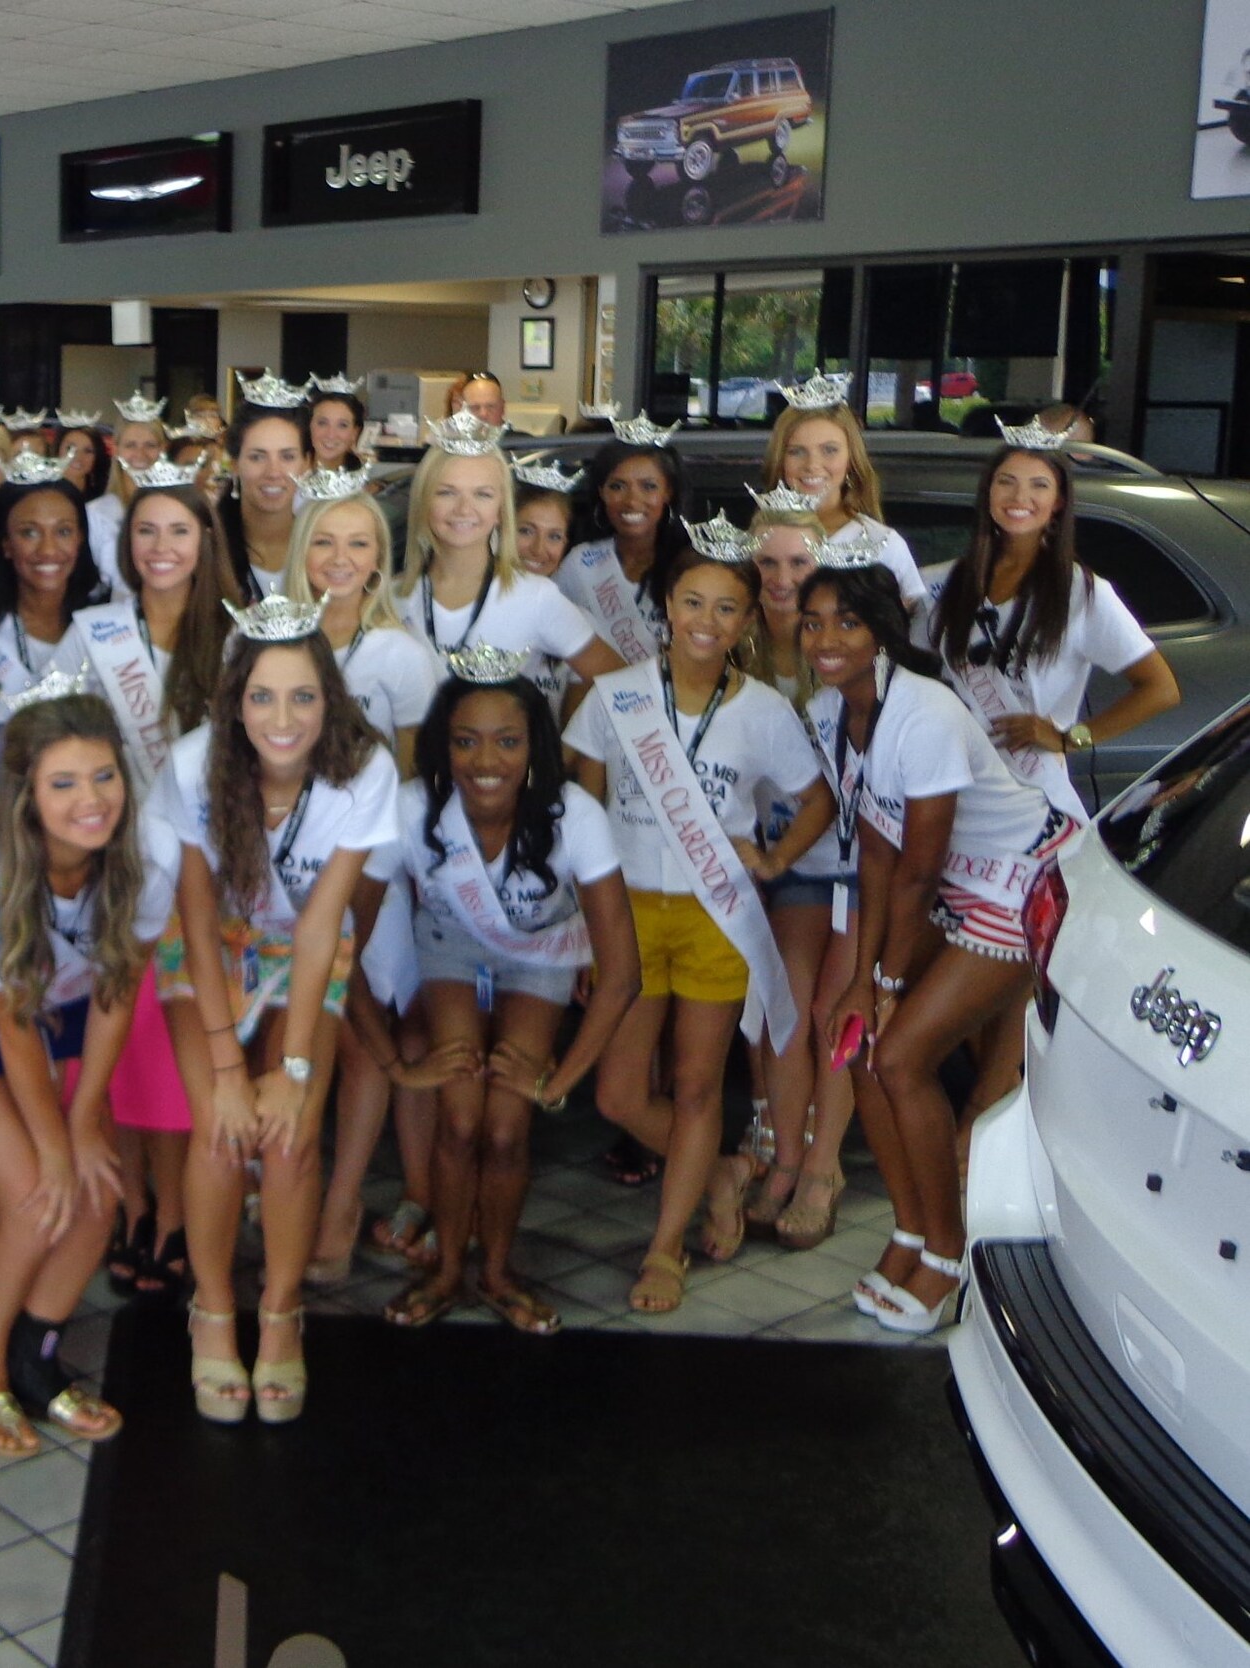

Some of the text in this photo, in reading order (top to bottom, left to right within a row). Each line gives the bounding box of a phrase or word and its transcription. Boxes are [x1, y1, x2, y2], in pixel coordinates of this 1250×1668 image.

[325, 143, 415, 192] Jeep
[112, 657, 156, 720] MISS
[631, 728, 741, 917] MISS CLARENDON
[946, 851, 999, 882] IDGE
[1130, 966, 1222, 1068] Jeep
